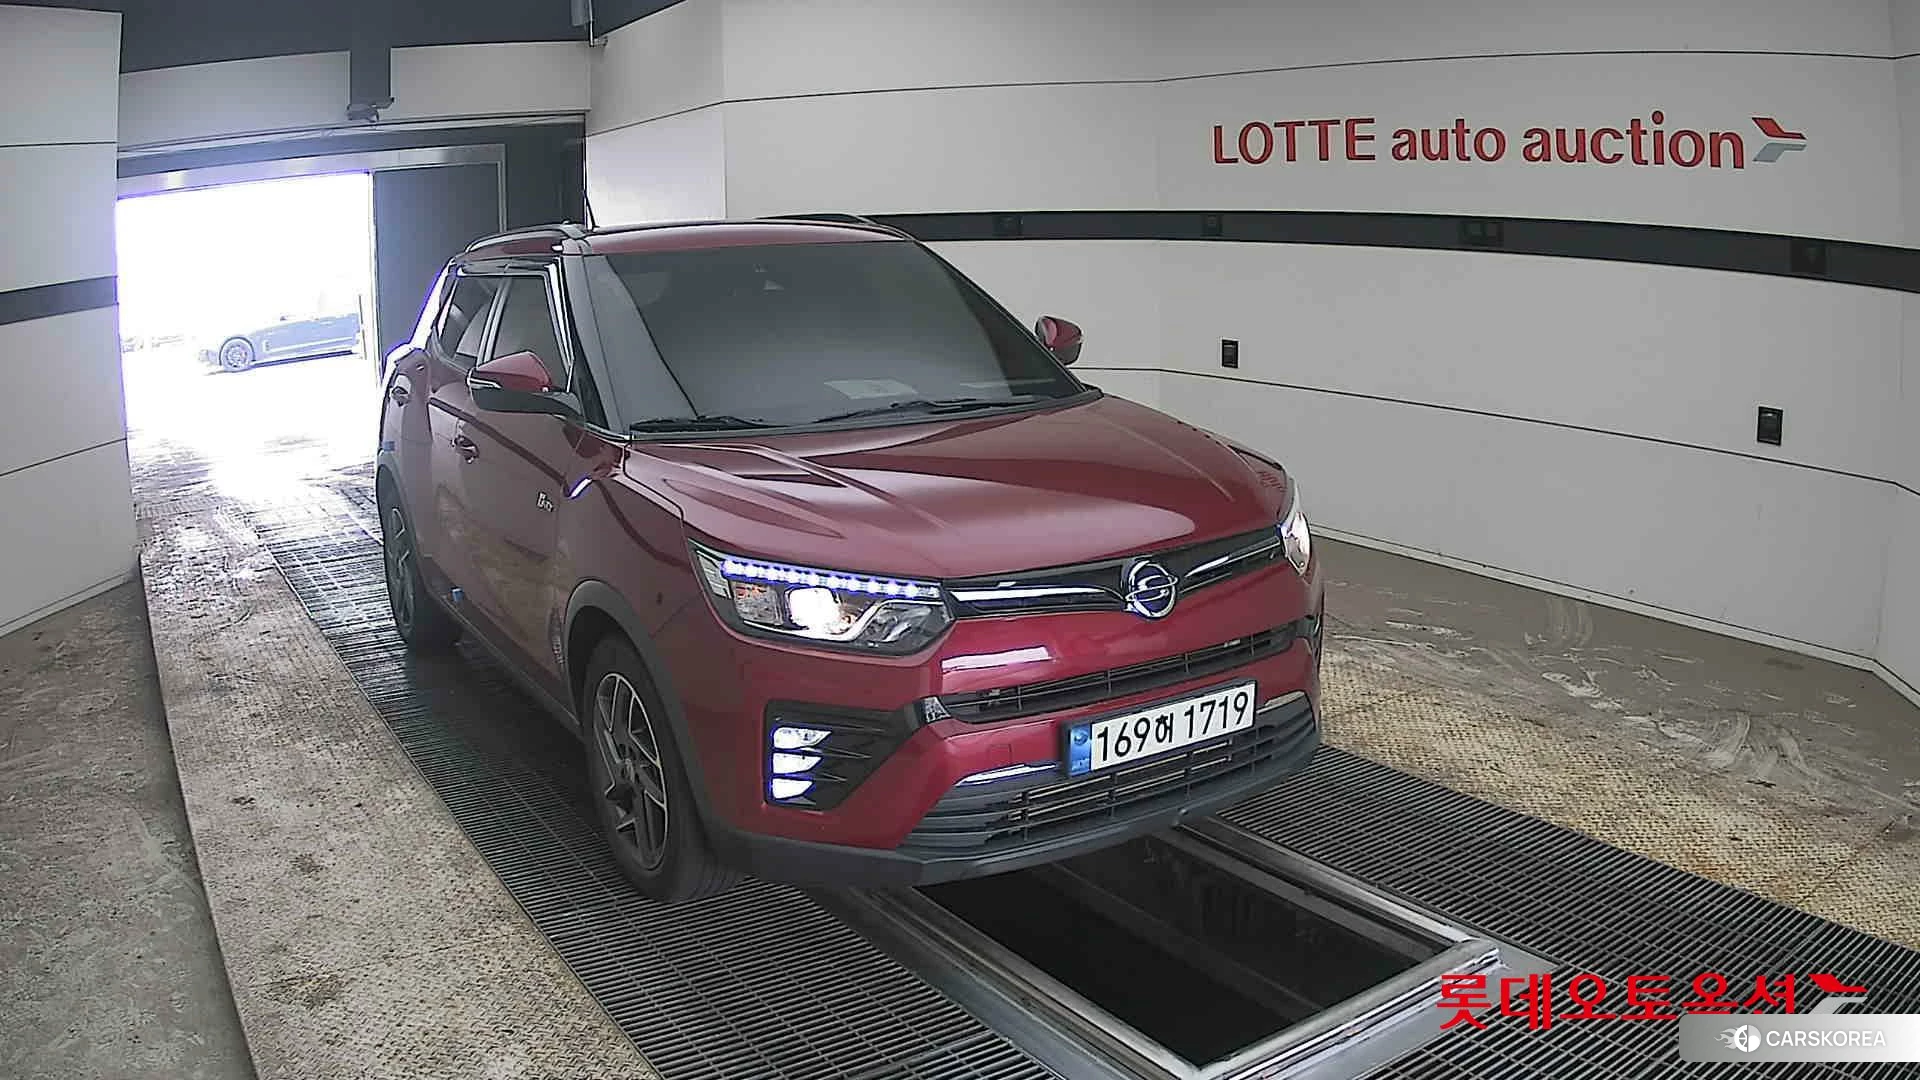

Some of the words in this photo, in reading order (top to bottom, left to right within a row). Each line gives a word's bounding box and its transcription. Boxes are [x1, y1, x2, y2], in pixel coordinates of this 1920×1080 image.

[1213, 118, 1376, 165] LOTTE
[1391, 118, 1507, 163] auto
[1522, 110, 1745, 170] auction
[1097, 712, 1174, 762] 169허
[1184, 691, 1249, 739] 1719
